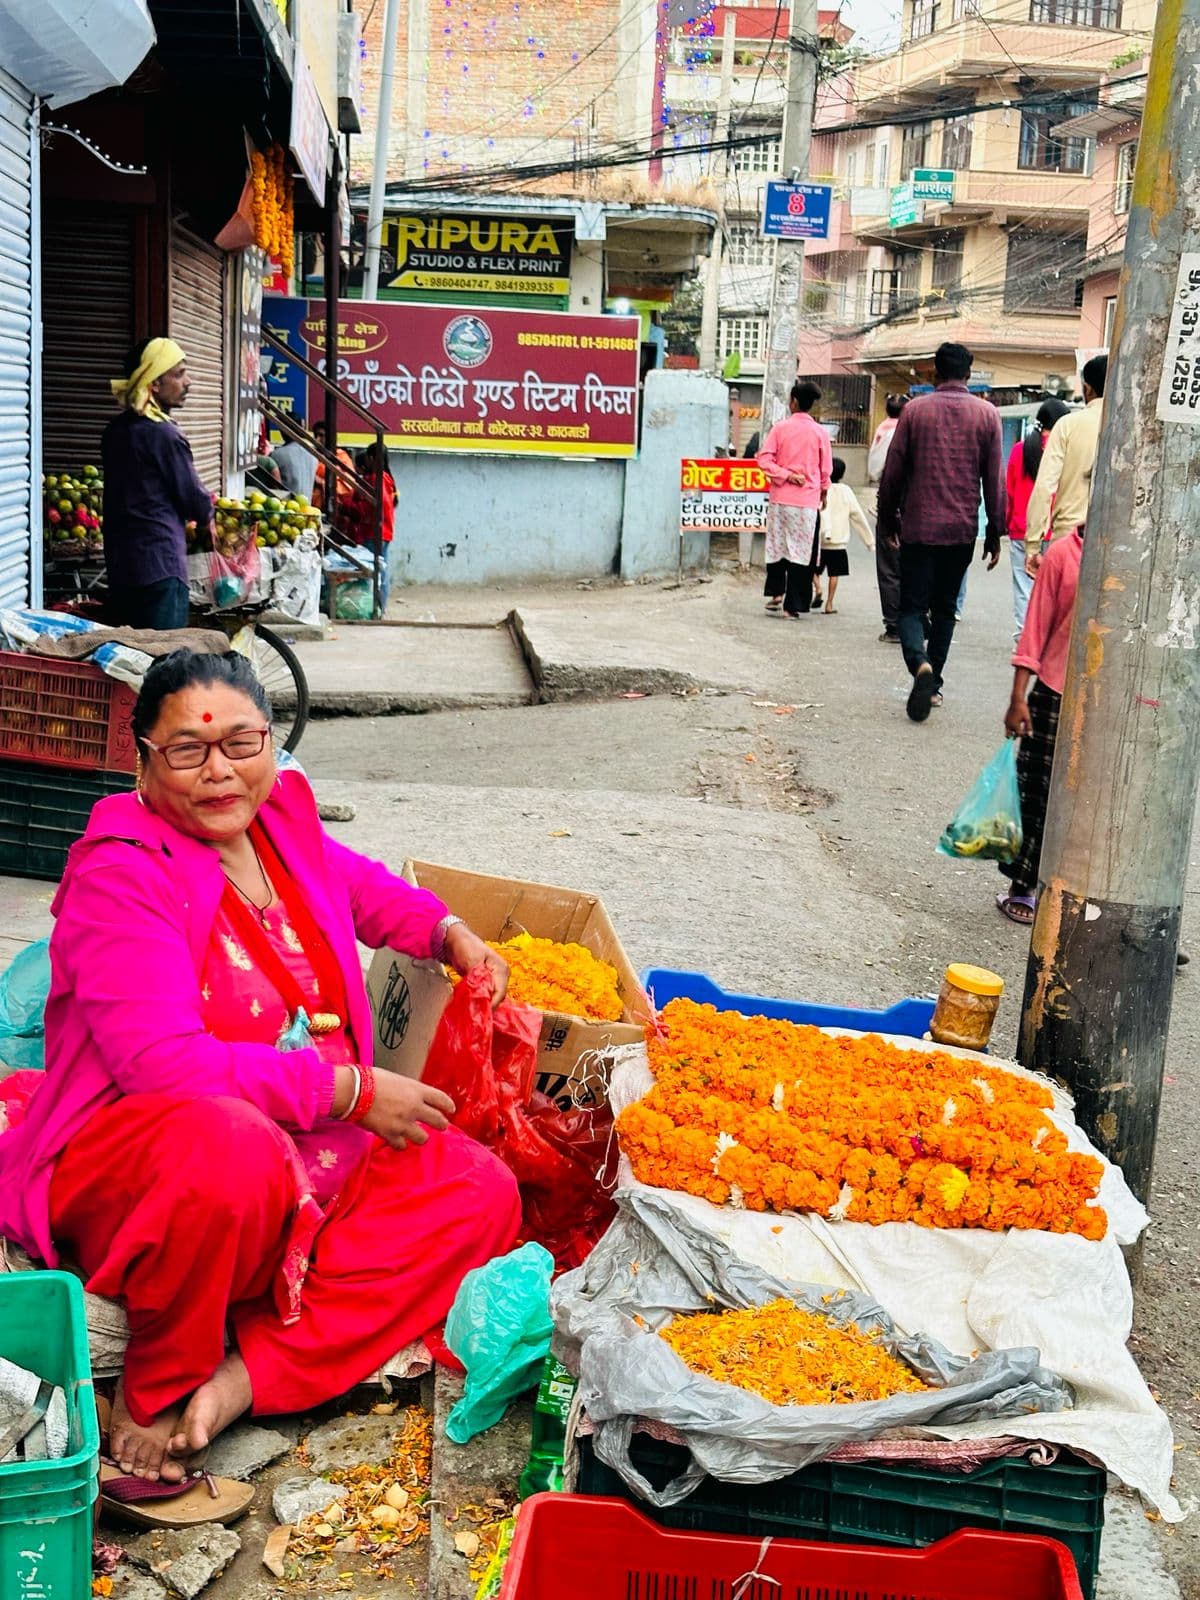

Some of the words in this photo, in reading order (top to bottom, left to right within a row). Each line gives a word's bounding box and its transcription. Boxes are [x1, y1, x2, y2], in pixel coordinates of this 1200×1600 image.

[409, 254, 464, 268] STUDIO
[467, 259, 477, 270] &
[480, 258, 515, 271] FLEX
[518, 260, 562, 273] PRINT
[316, 335, 367, 350] Pking
[472, 379, 519, 418] एण्ड
[522, 369, 580, 413] स्टिम
[583, 372, 636, 415] फिस
[682, 460, 725, 488] गेष्ट
[730, 466, 769, 491] हाउ
